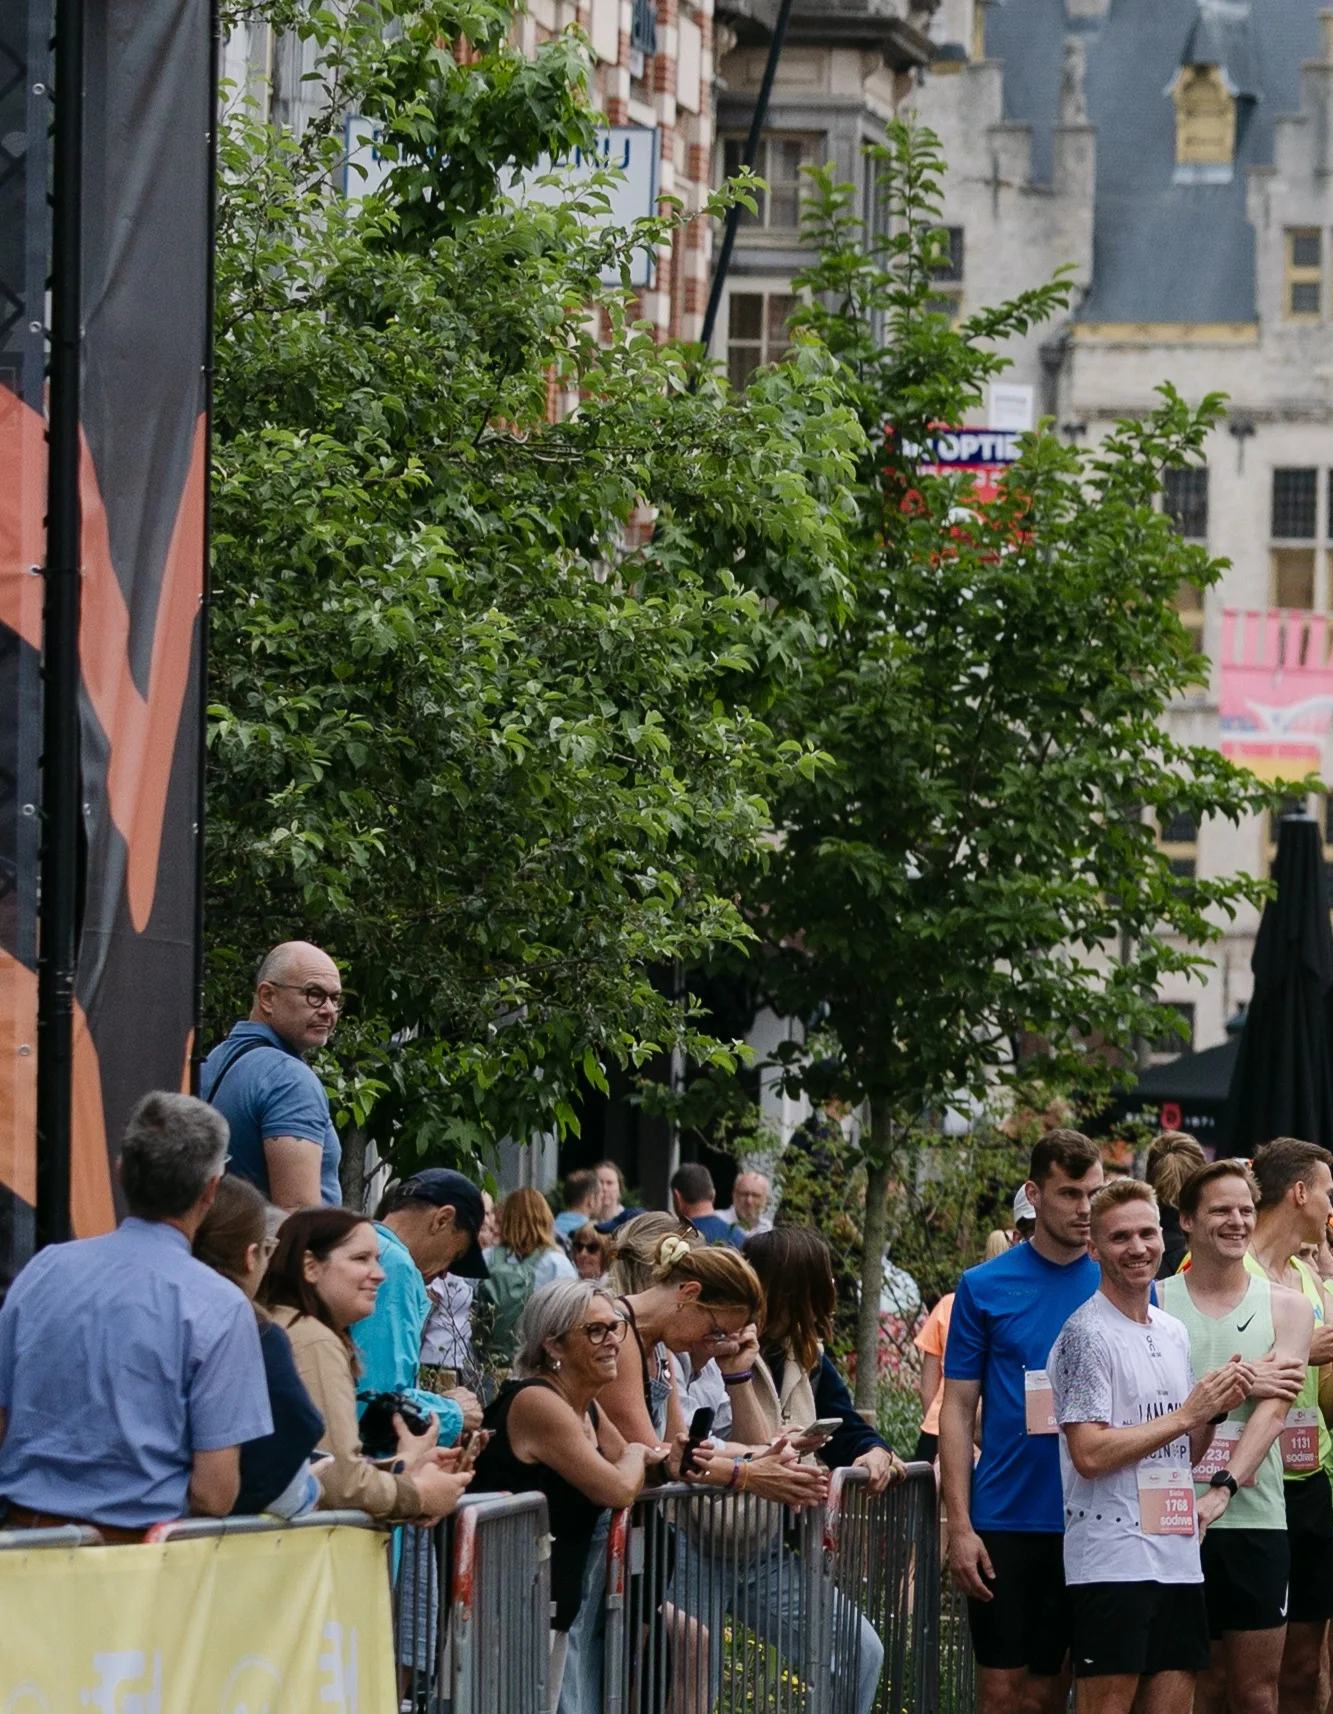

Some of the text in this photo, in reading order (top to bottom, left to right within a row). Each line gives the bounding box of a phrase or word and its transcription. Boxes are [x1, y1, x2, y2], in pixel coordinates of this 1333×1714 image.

[1291, 1436, 1311, 1449] 1131
[1203, 1448, 1230, 1462] 234
[1165, 1499, 1189, 1512] 1768
